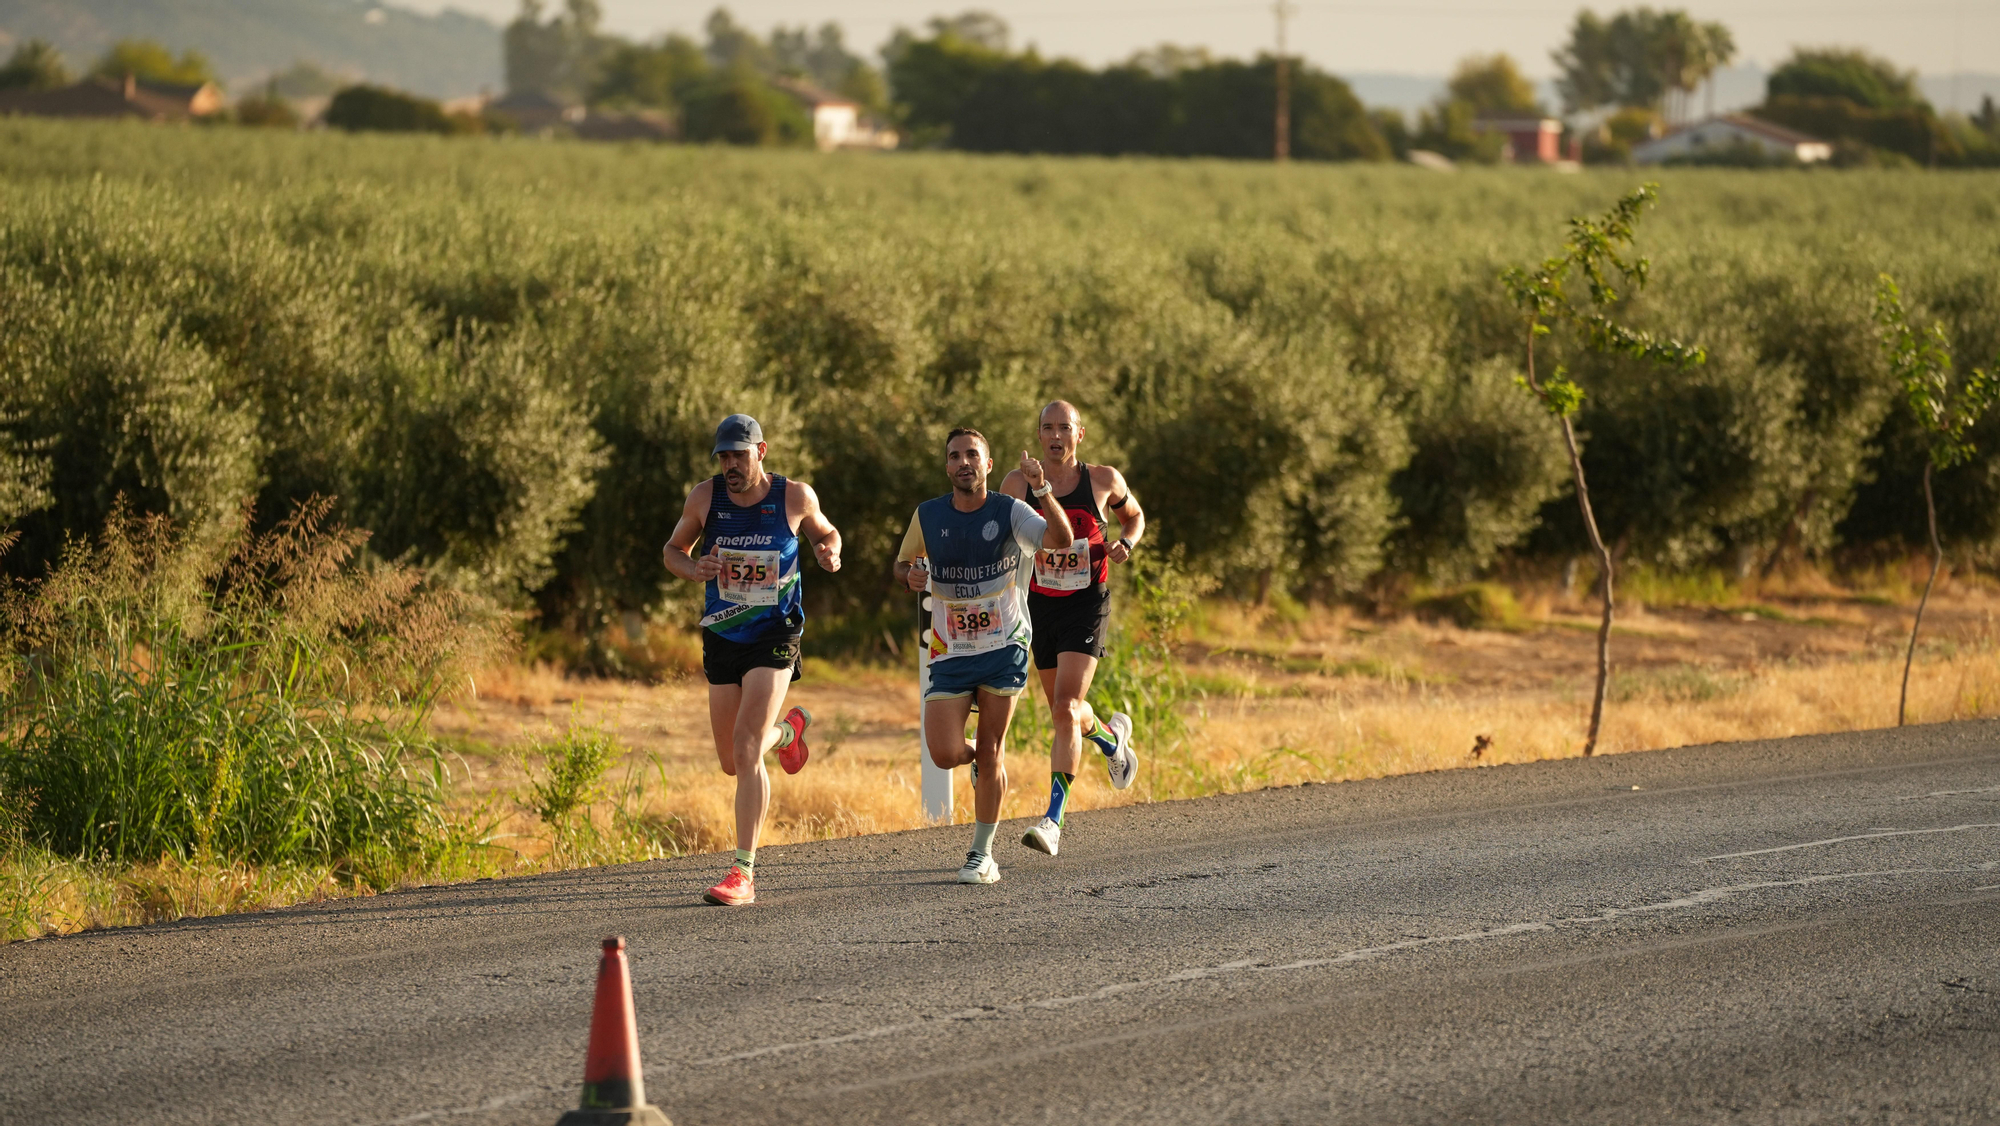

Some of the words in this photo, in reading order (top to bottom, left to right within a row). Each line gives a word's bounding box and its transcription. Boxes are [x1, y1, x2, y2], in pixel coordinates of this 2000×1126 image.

[715, 533, 773, 548] enerplus
[942, 555, 1016, 581] MOSQUETEROS
[1045, 553, 1079, 568] 478
[731, 564, 767, 581] 525
[955, 583, 981, 599] ÉCIJA
[956, 611, 991, 630] 388
